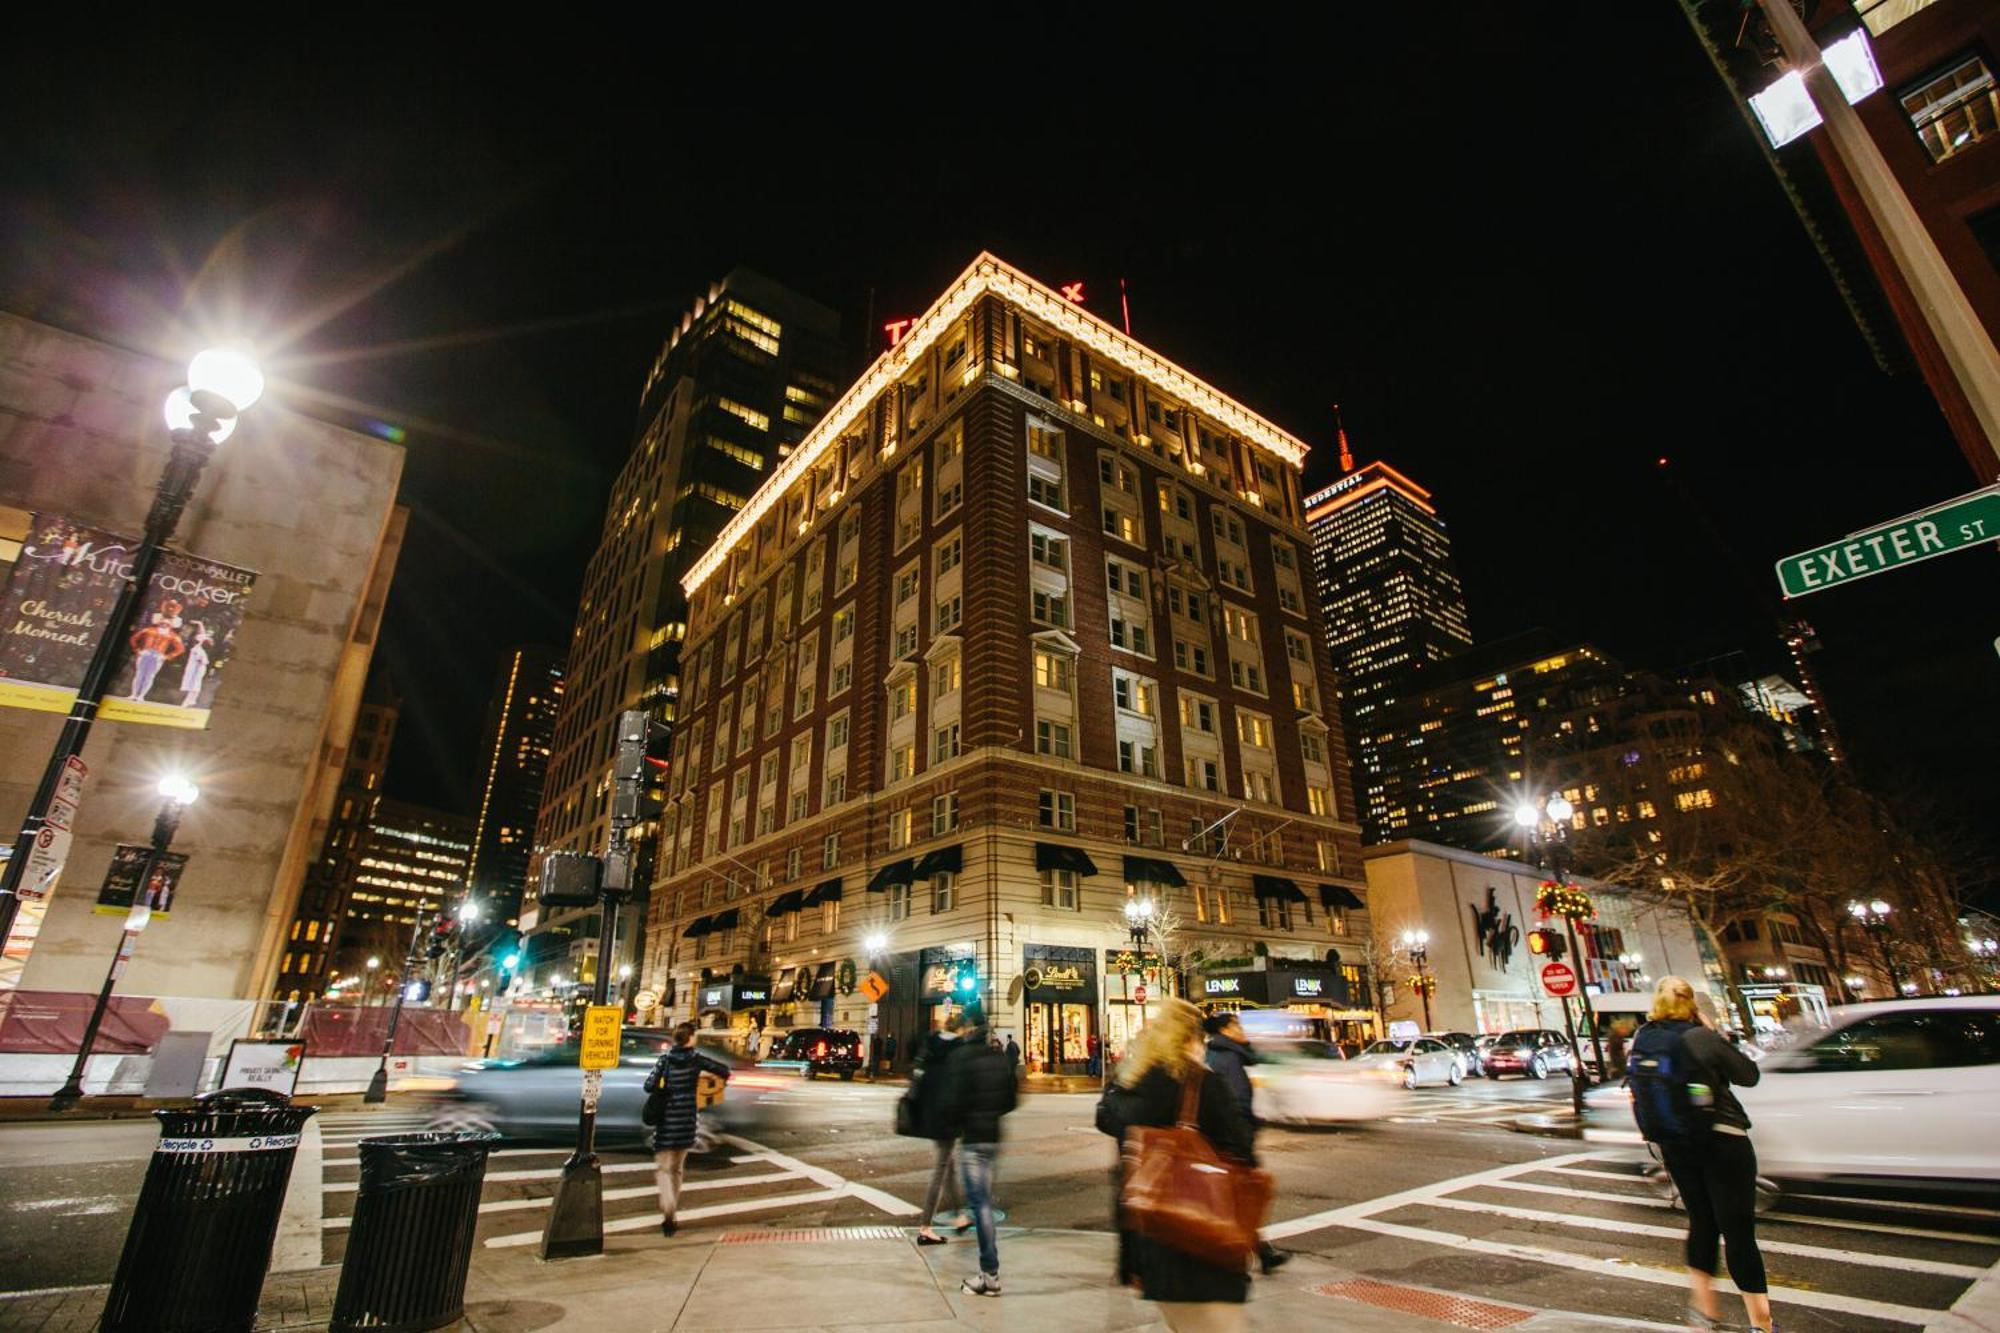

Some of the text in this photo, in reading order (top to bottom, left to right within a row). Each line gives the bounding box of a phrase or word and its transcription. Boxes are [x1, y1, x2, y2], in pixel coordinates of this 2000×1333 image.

[1303, 475, 1363, 508] RUDENTIAL
[1798, 519, 1985, 588] EXETER ST
[20, 600, 96, 627] Cherish
[7, 620, 88, 646] Moment
[1205, 979, 1239, 992] LENOX
[1295, 978, 1321, 992] LENOX
[594, 1016, 614, 1024] WATCH
[596, 1027, 608, 1035] FOR
[589, 1039, 614, 1047] TURNING
[585, 1051, 614, 1060] VEHICLES
[162, 1139, 197, 1151] Recycle
